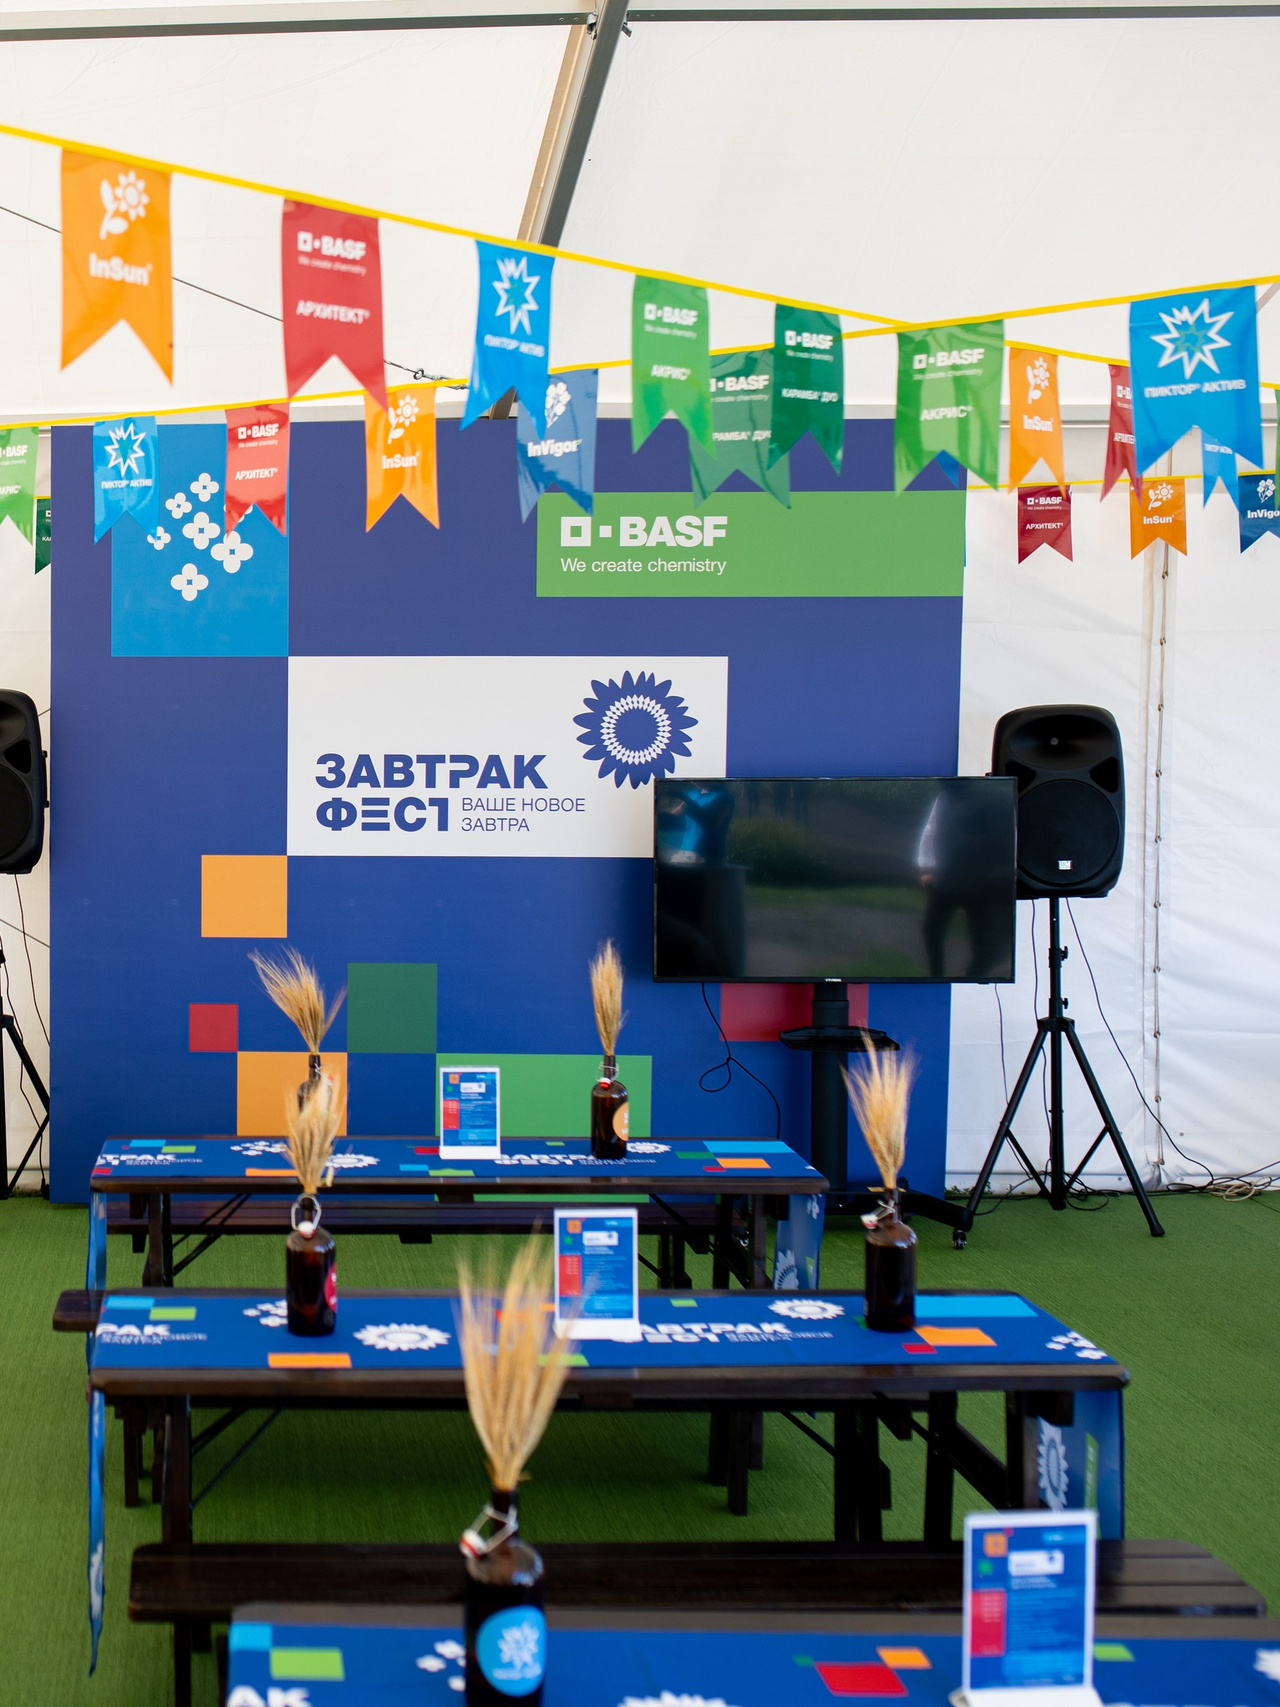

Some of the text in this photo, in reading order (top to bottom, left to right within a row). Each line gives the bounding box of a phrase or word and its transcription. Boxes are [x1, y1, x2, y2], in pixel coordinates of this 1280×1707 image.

[321, 235, 366, 261] BASF
[88, 252, 149, 286] InSun
[662, 306, 698, 326] BASF
[802, 332, 834, 349] BASF
[936, 348, 985, 367] BASF
[725, 375, 770, 391] BASF
[1201, 379, 1247, 394] АКТИВ
[252, 424, 278, 437] BASF
[1023, 414, 1053, 432] InSun
[712, 431, 748, 441] РАМБА
[6, 445, 28, 457] BASF
[527, 439, 581, 458] InVigor
[382, 454, 417, 470] InSun
[235, 468, 274, 480] АРХИТЕКТ
[1039, 496, 1062, 506] BASF
[1143, 515, 1172, 524] InSun
[1247, 509, 1280, 519] InVigo
[619, 515, 728, 547] BASF
[560, 557, 726, 576] We create chemistry
[315, 753, 548, 789] ЗАВТРАК
[461, 797, 586, 812] ВАШЕ НОВОЕ
[316, 796, 449, 832] ФЕСТ
[461, 817, 530, 832] ЗАВТРА
[641, 1323, 793, 1334] АВТРАК
[645, 1333, 719, 1343] ЕСТ
